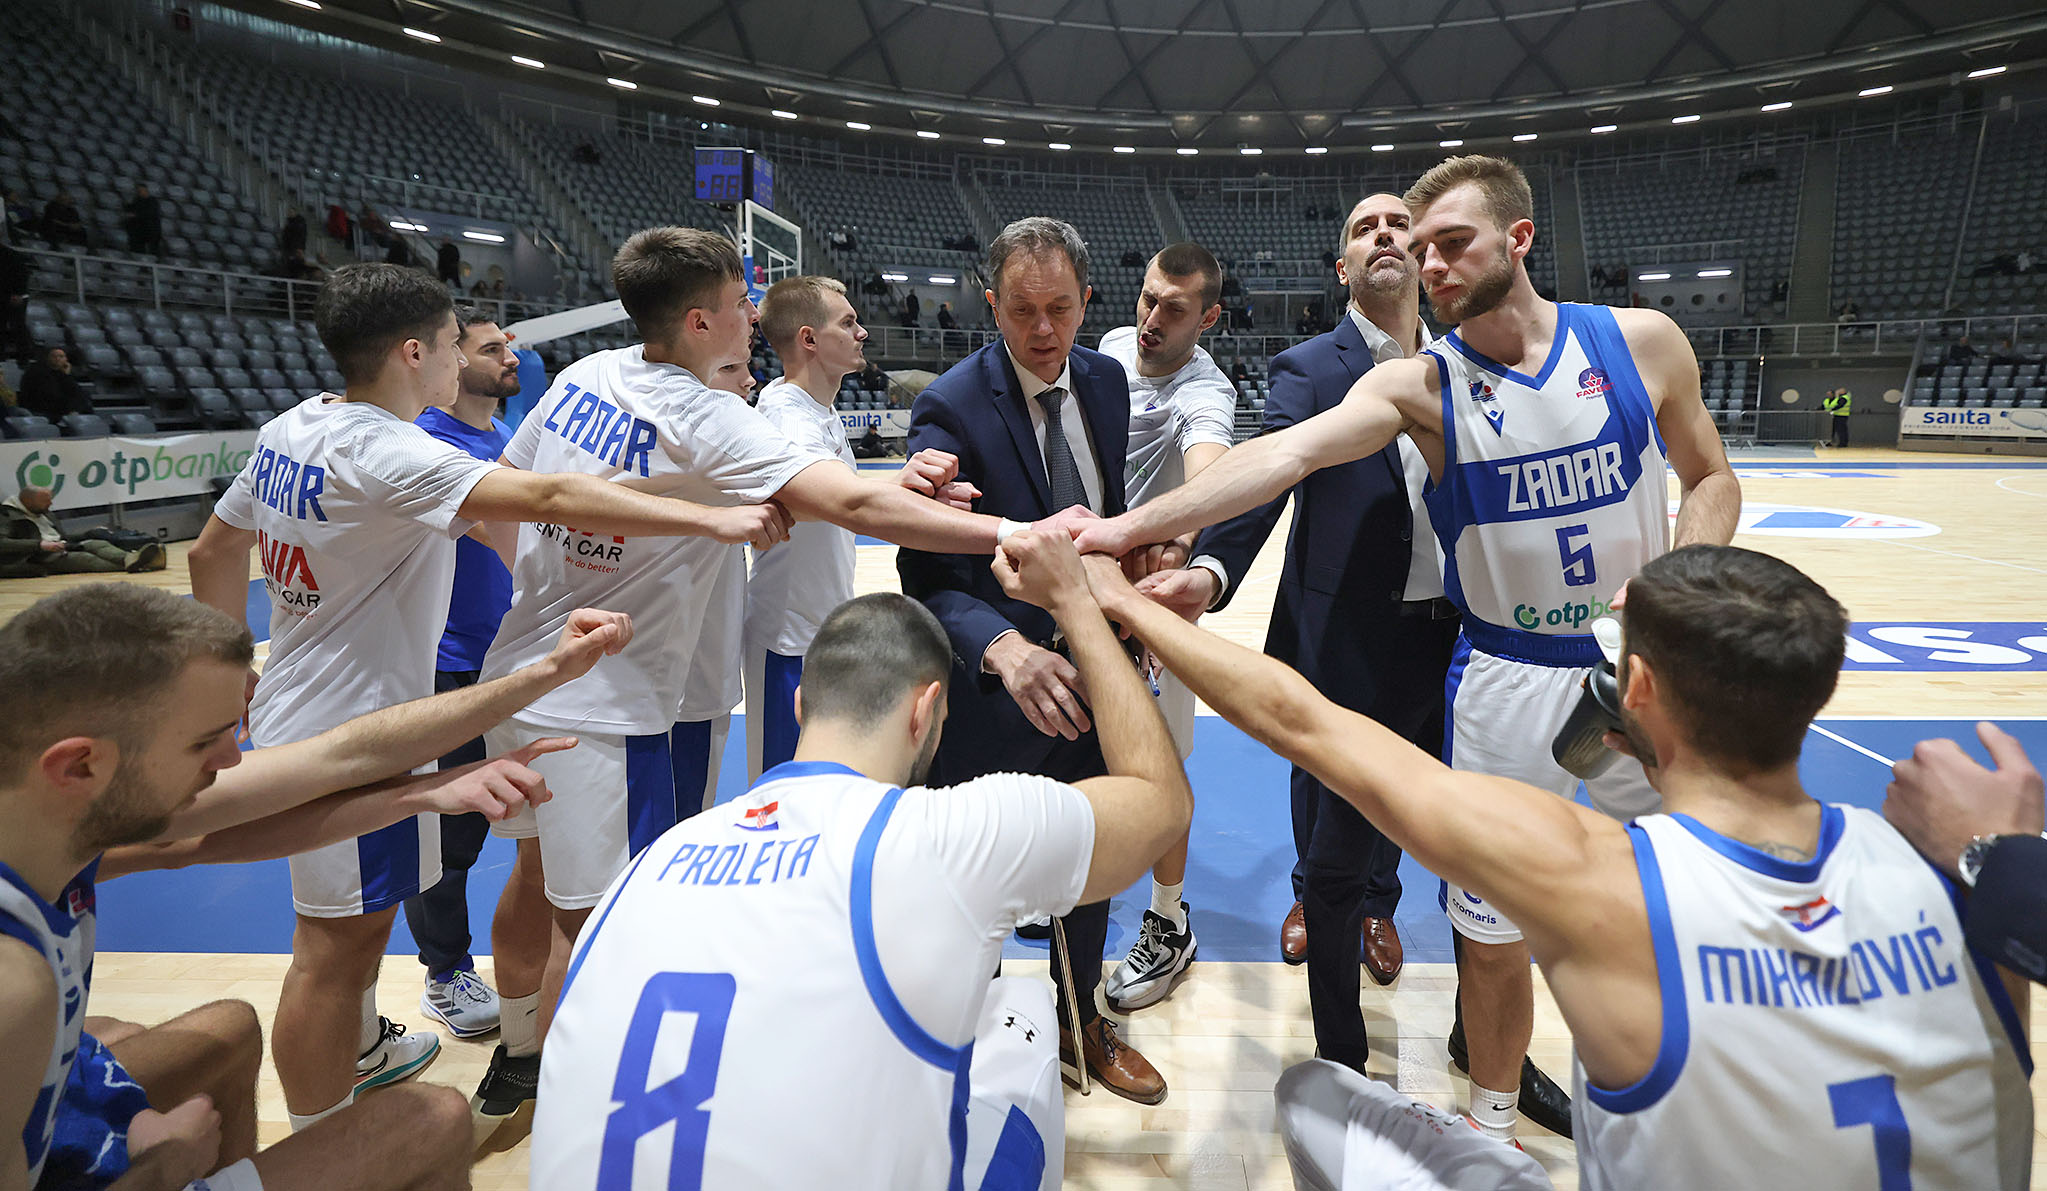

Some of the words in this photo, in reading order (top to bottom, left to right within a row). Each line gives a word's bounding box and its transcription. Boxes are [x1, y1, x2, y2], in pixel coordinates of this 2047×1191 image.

[544, 382, 657, 478] ZADAR
[840, 412, 882, 427] santa
[1923, 409, 1991, 425] santa
[1498, 442, 1628, 512] ZADAR
[575, 560, 586, 568] do
[587, 562, 620, 574] better!
[577, 540, 623, 562] CAR
[1555, 524, 1597, 586] 5
[282, 590, 321, 608] CAR
[657, 833, 821, 886] PROLETA
[1452, 898, 1497, 925] cromaris
[1698, 910, 1958, 1007] MIHAILOVIĆ
[596, 971, 737, 1191] 8
